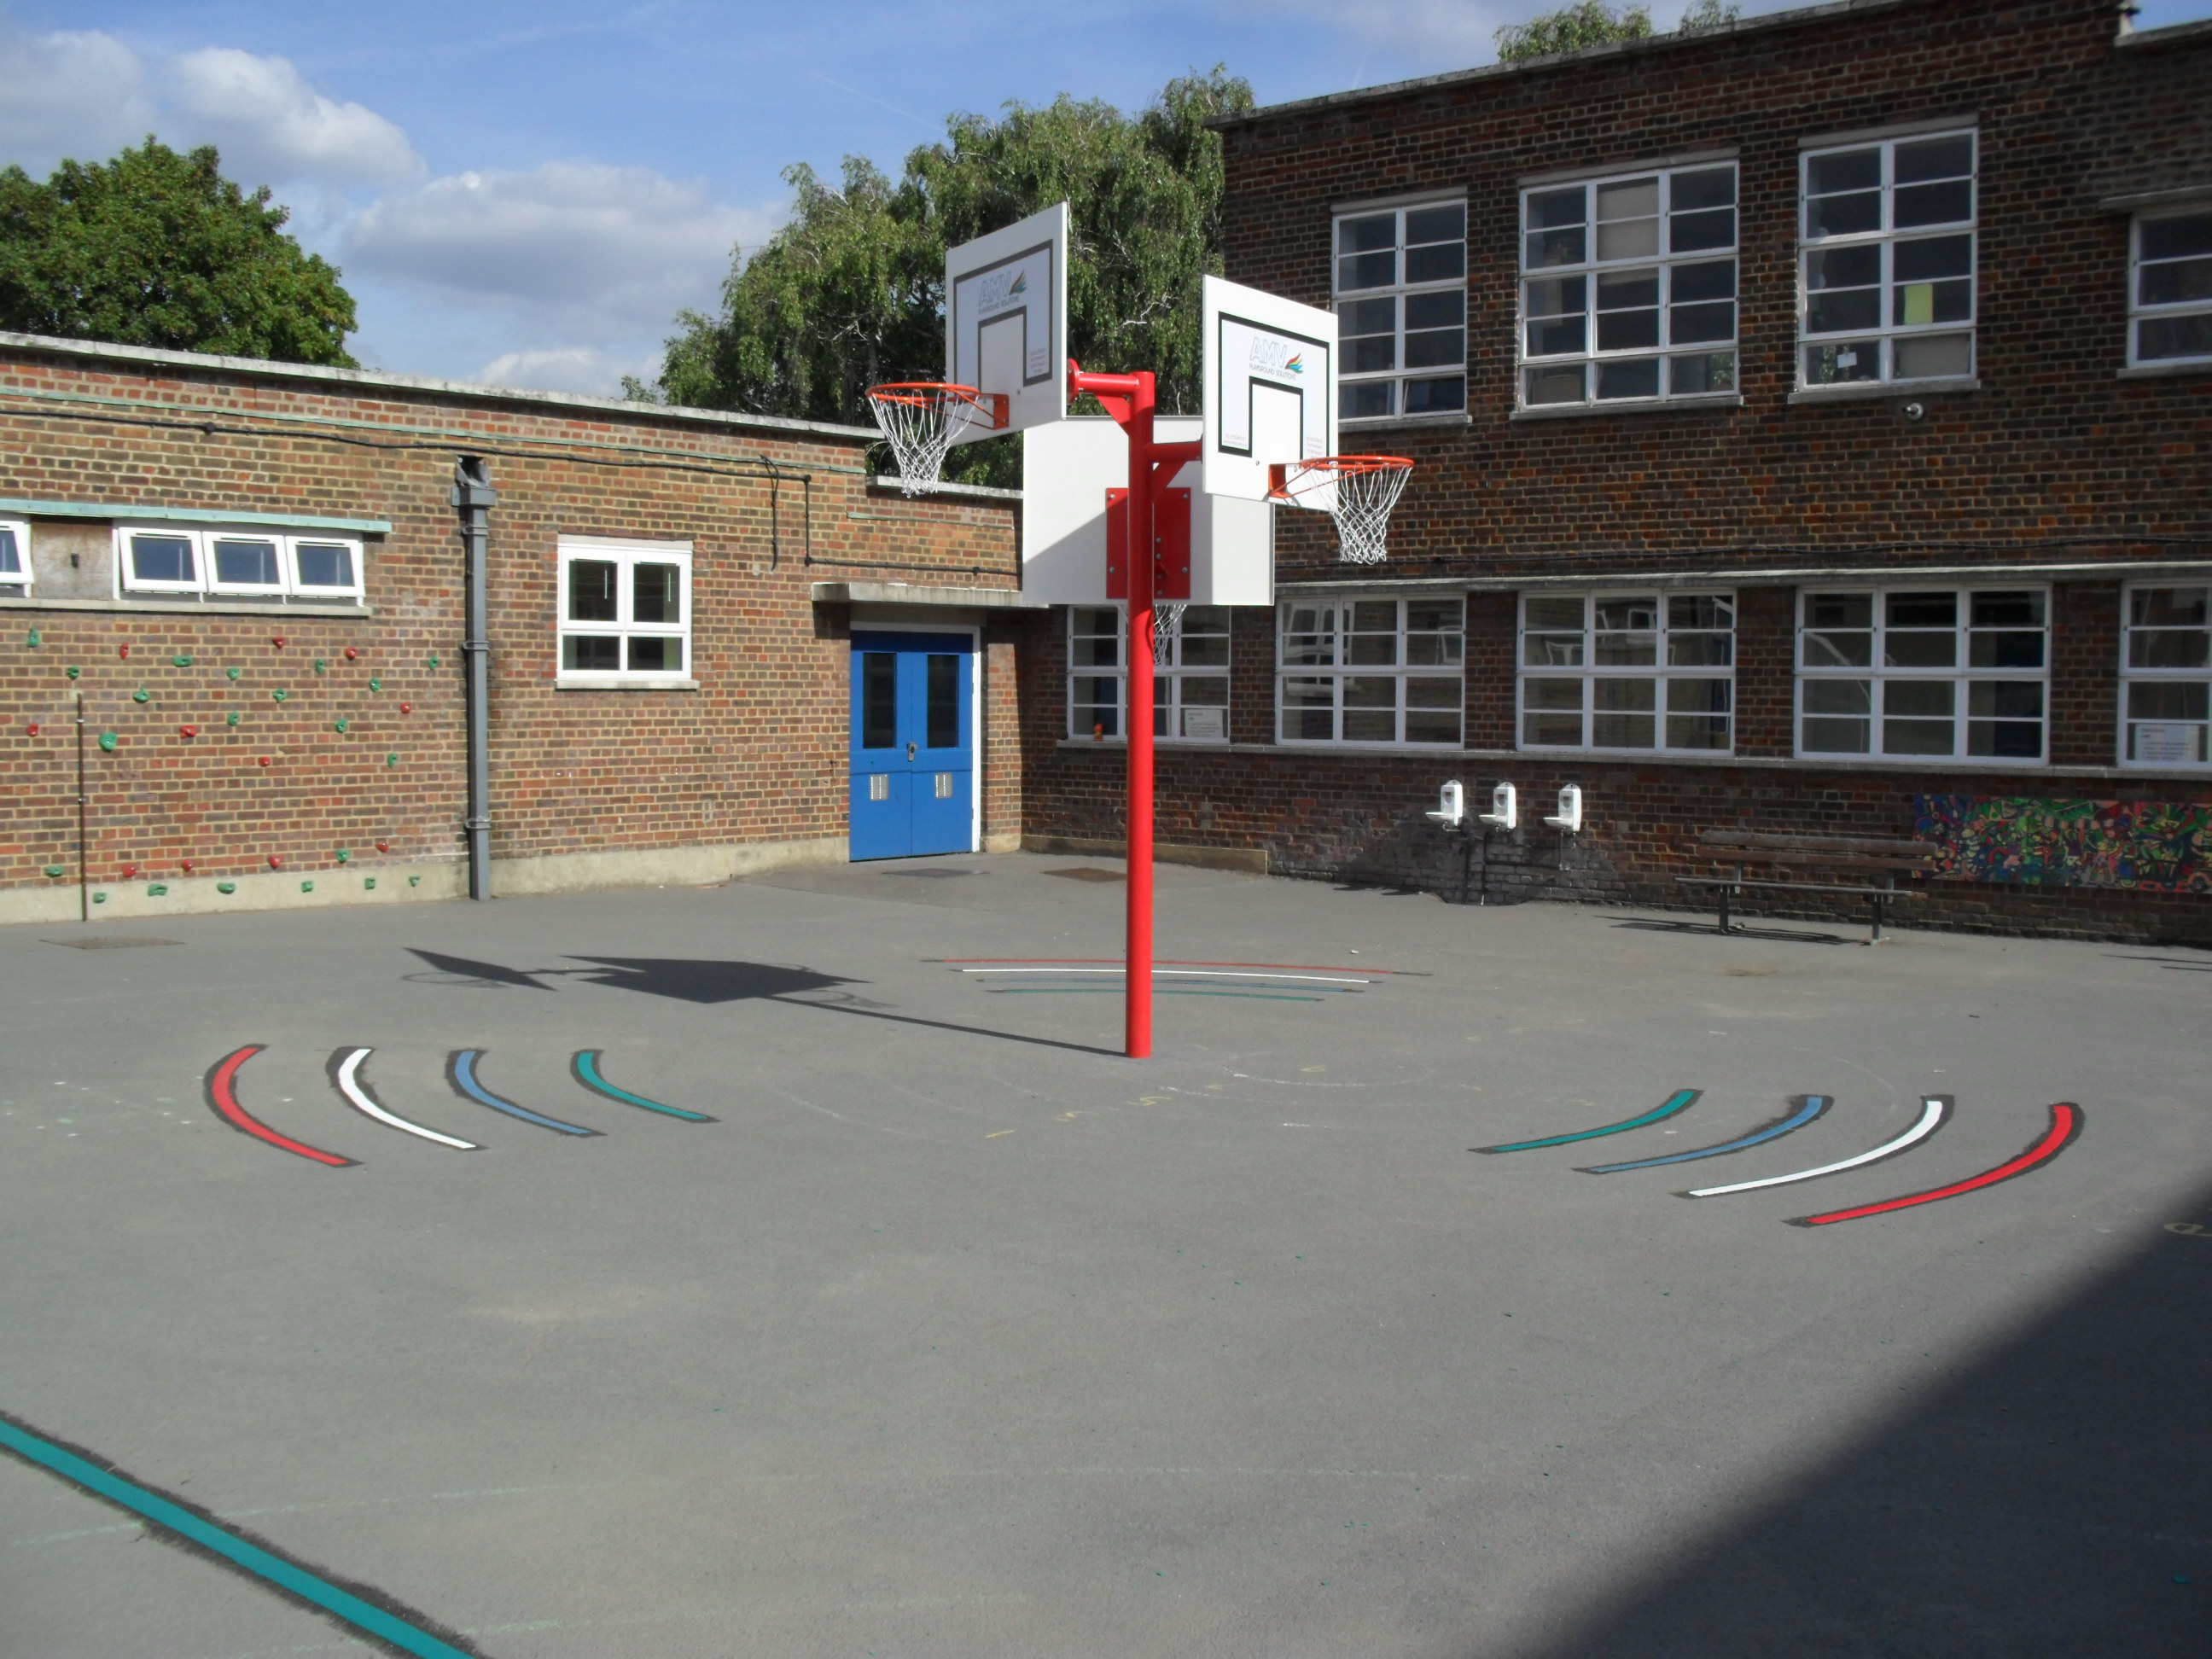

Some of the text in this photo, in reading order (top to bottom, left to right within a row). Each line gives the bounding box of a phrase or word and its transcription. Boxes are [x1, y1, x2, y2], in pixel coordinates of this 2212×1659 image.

[978, 271, 1012, 306] AMV
[1249, 336, 1288, 368] AMV
[1249, 363, 1296, 381] PLAYGROUND SOLUTIONS
